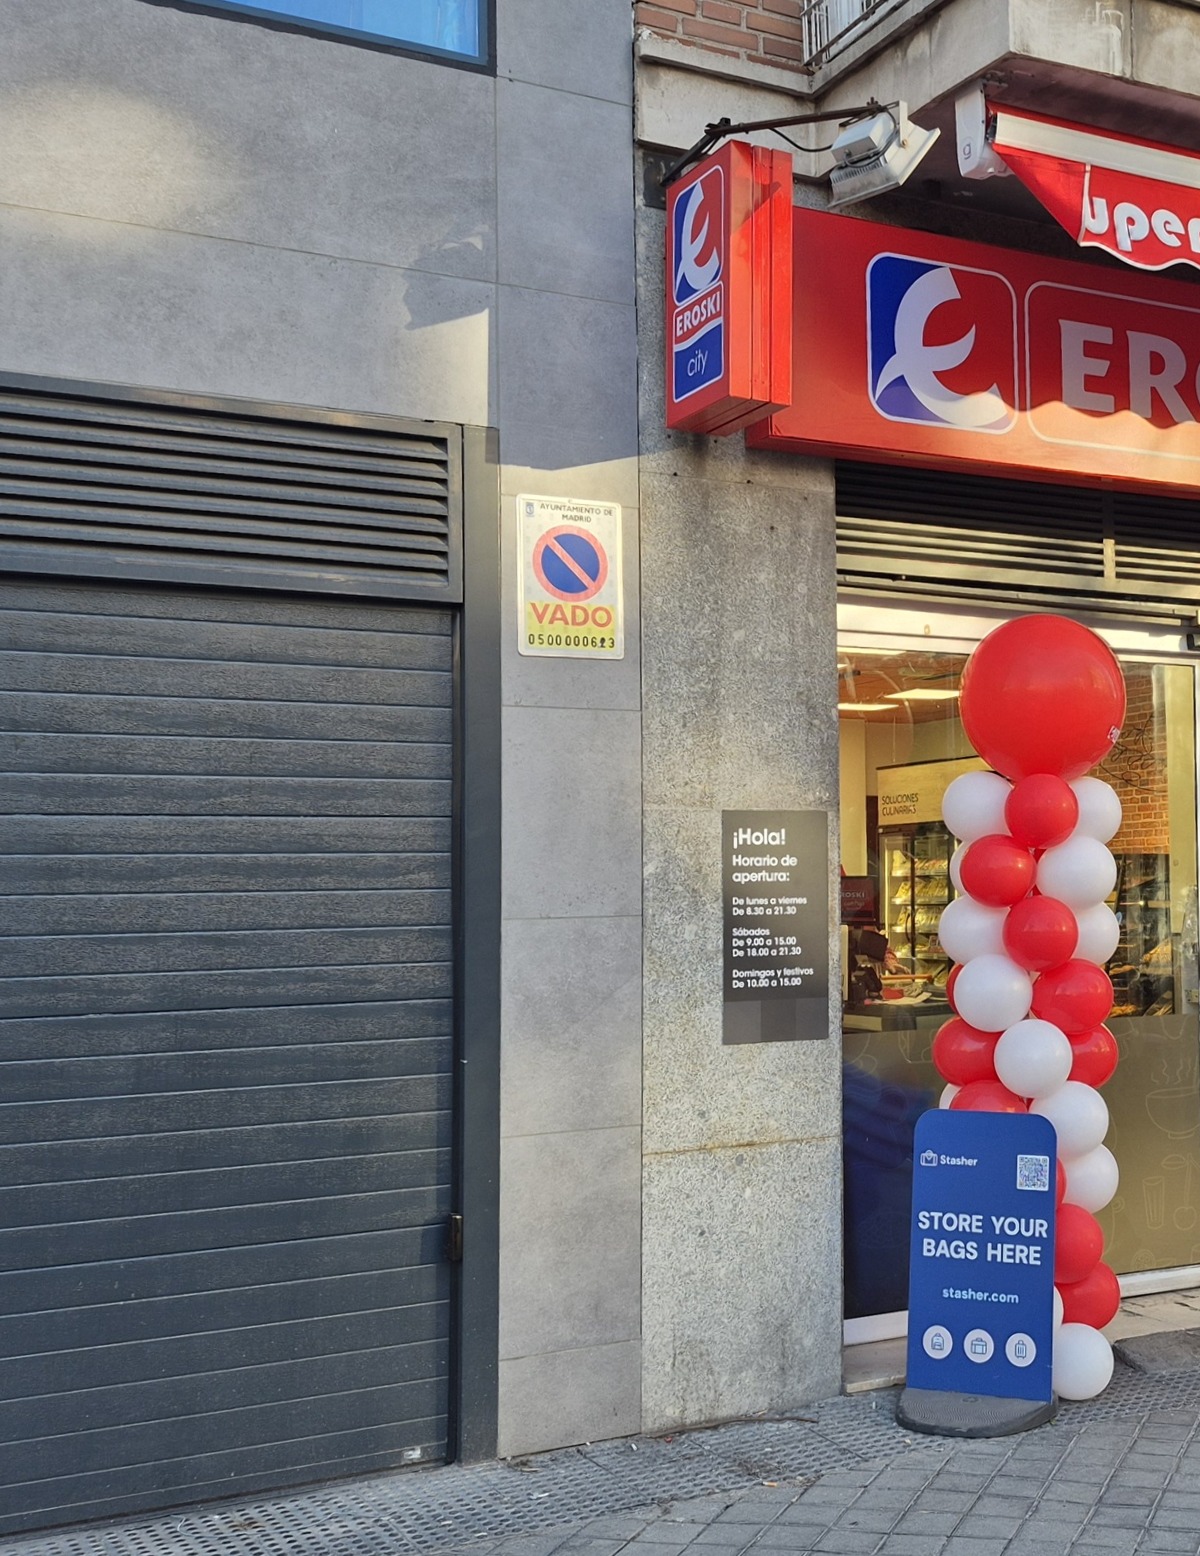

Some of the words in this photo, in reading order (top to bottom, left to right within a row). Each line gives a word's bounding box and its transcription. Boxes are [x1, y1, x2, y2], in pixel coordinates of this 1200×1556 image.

[676, 291, 720, 337] EROSKI
[687, 349, 708, 376] city
[540, 503, 601, 515] AYUNTAMIENTO
[562, 514, 591, 523] MADRID
[530, 602, 612, 628] VADO
[882, 793, 918, 805] SOLUCIONES
[733, 828, 786, 849] ¡Hola!
[733, 854, 778, 866] Horario
[780, 854, 797, 866] de
[732, 870, 790, 884] apertura:
[732, 897, 744, 905] De
[746, 897, 768, 905] lunes
[778, 896, 807, 904] viernes
[732, 907, 744, 915] De
[746, 907, 764, 915] 8.30
[774, 906, 796, 915] 21.30
[732, 927, 770, 936] Sábados
[732, 938, 744, 946] De
[746, 938, 764, 946] 9.00
[775, 936, 796, 945] 15.00
[732, 949, 744, 957] De
[747, 948, 769, 956] 18.00
[779, 947, 801, 956] 21.30
[732, 969, 775, 978] Domingos
[776, 970, 782, 978] y
[783, 967, 814, 976] festivos
[732, 980, 744, 988] De
[747, 979, 769, 987] 10.00
[780, 977, 801, 986] 15.00
[940, 1154, 978, 1166] Stasher
[918, 1210, 983, 1234] STORE
[991, 1216, 1048, 1238] YOUR
[922, 1238, 978, 1261] BAGS
[987, 1242, 1041, 1265] HERE
[942, 1287, 1019, 1304] stasher.com
